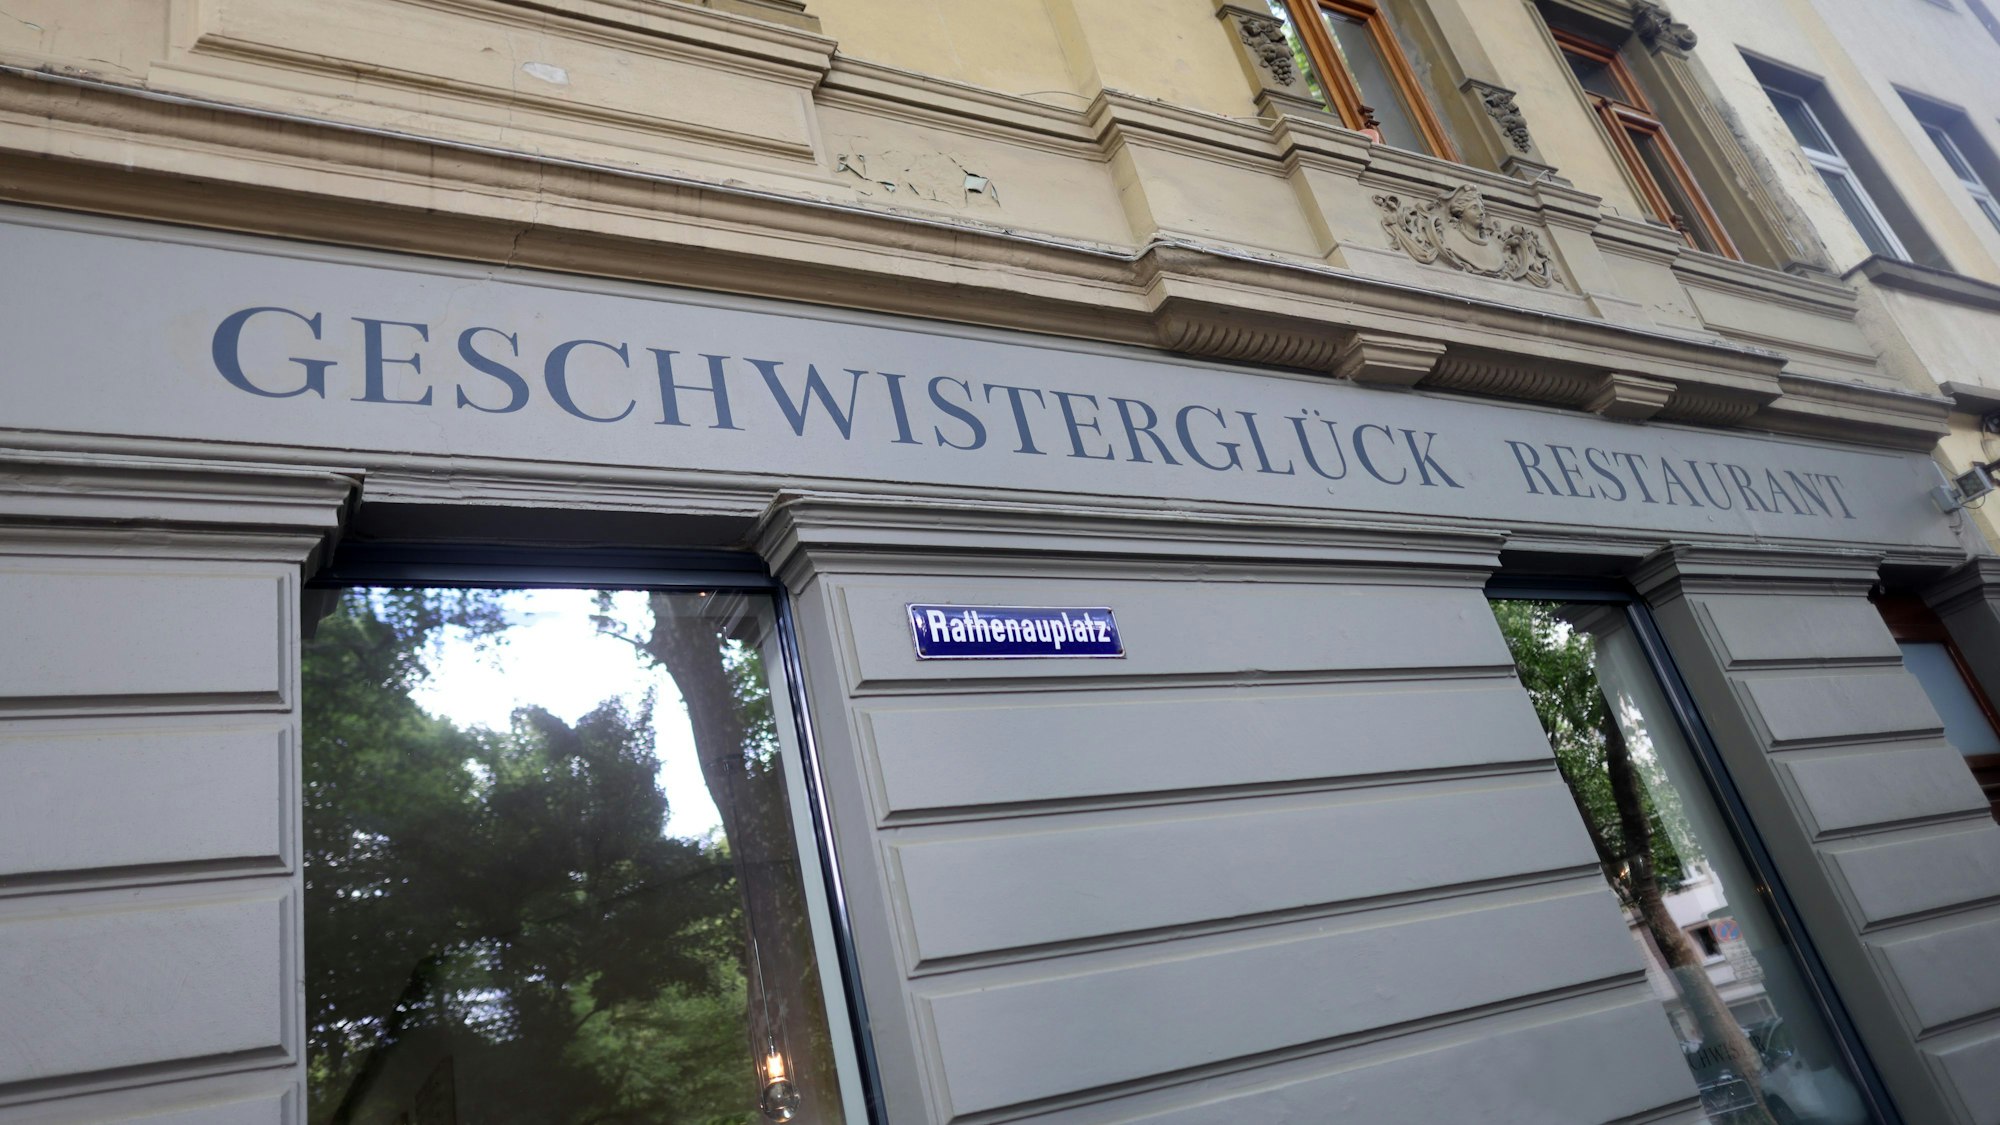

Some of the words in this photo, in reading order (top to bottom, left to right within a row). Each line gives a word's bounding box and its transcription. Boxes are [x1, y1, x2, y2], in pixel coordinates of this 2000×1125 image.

[212, 307, 1464, 488] GESCHWISTERGLÜCK
[1504, 440, 1855, 519] RESTAURANT
[927, 609, 1112, 650] Rathenauplatz
